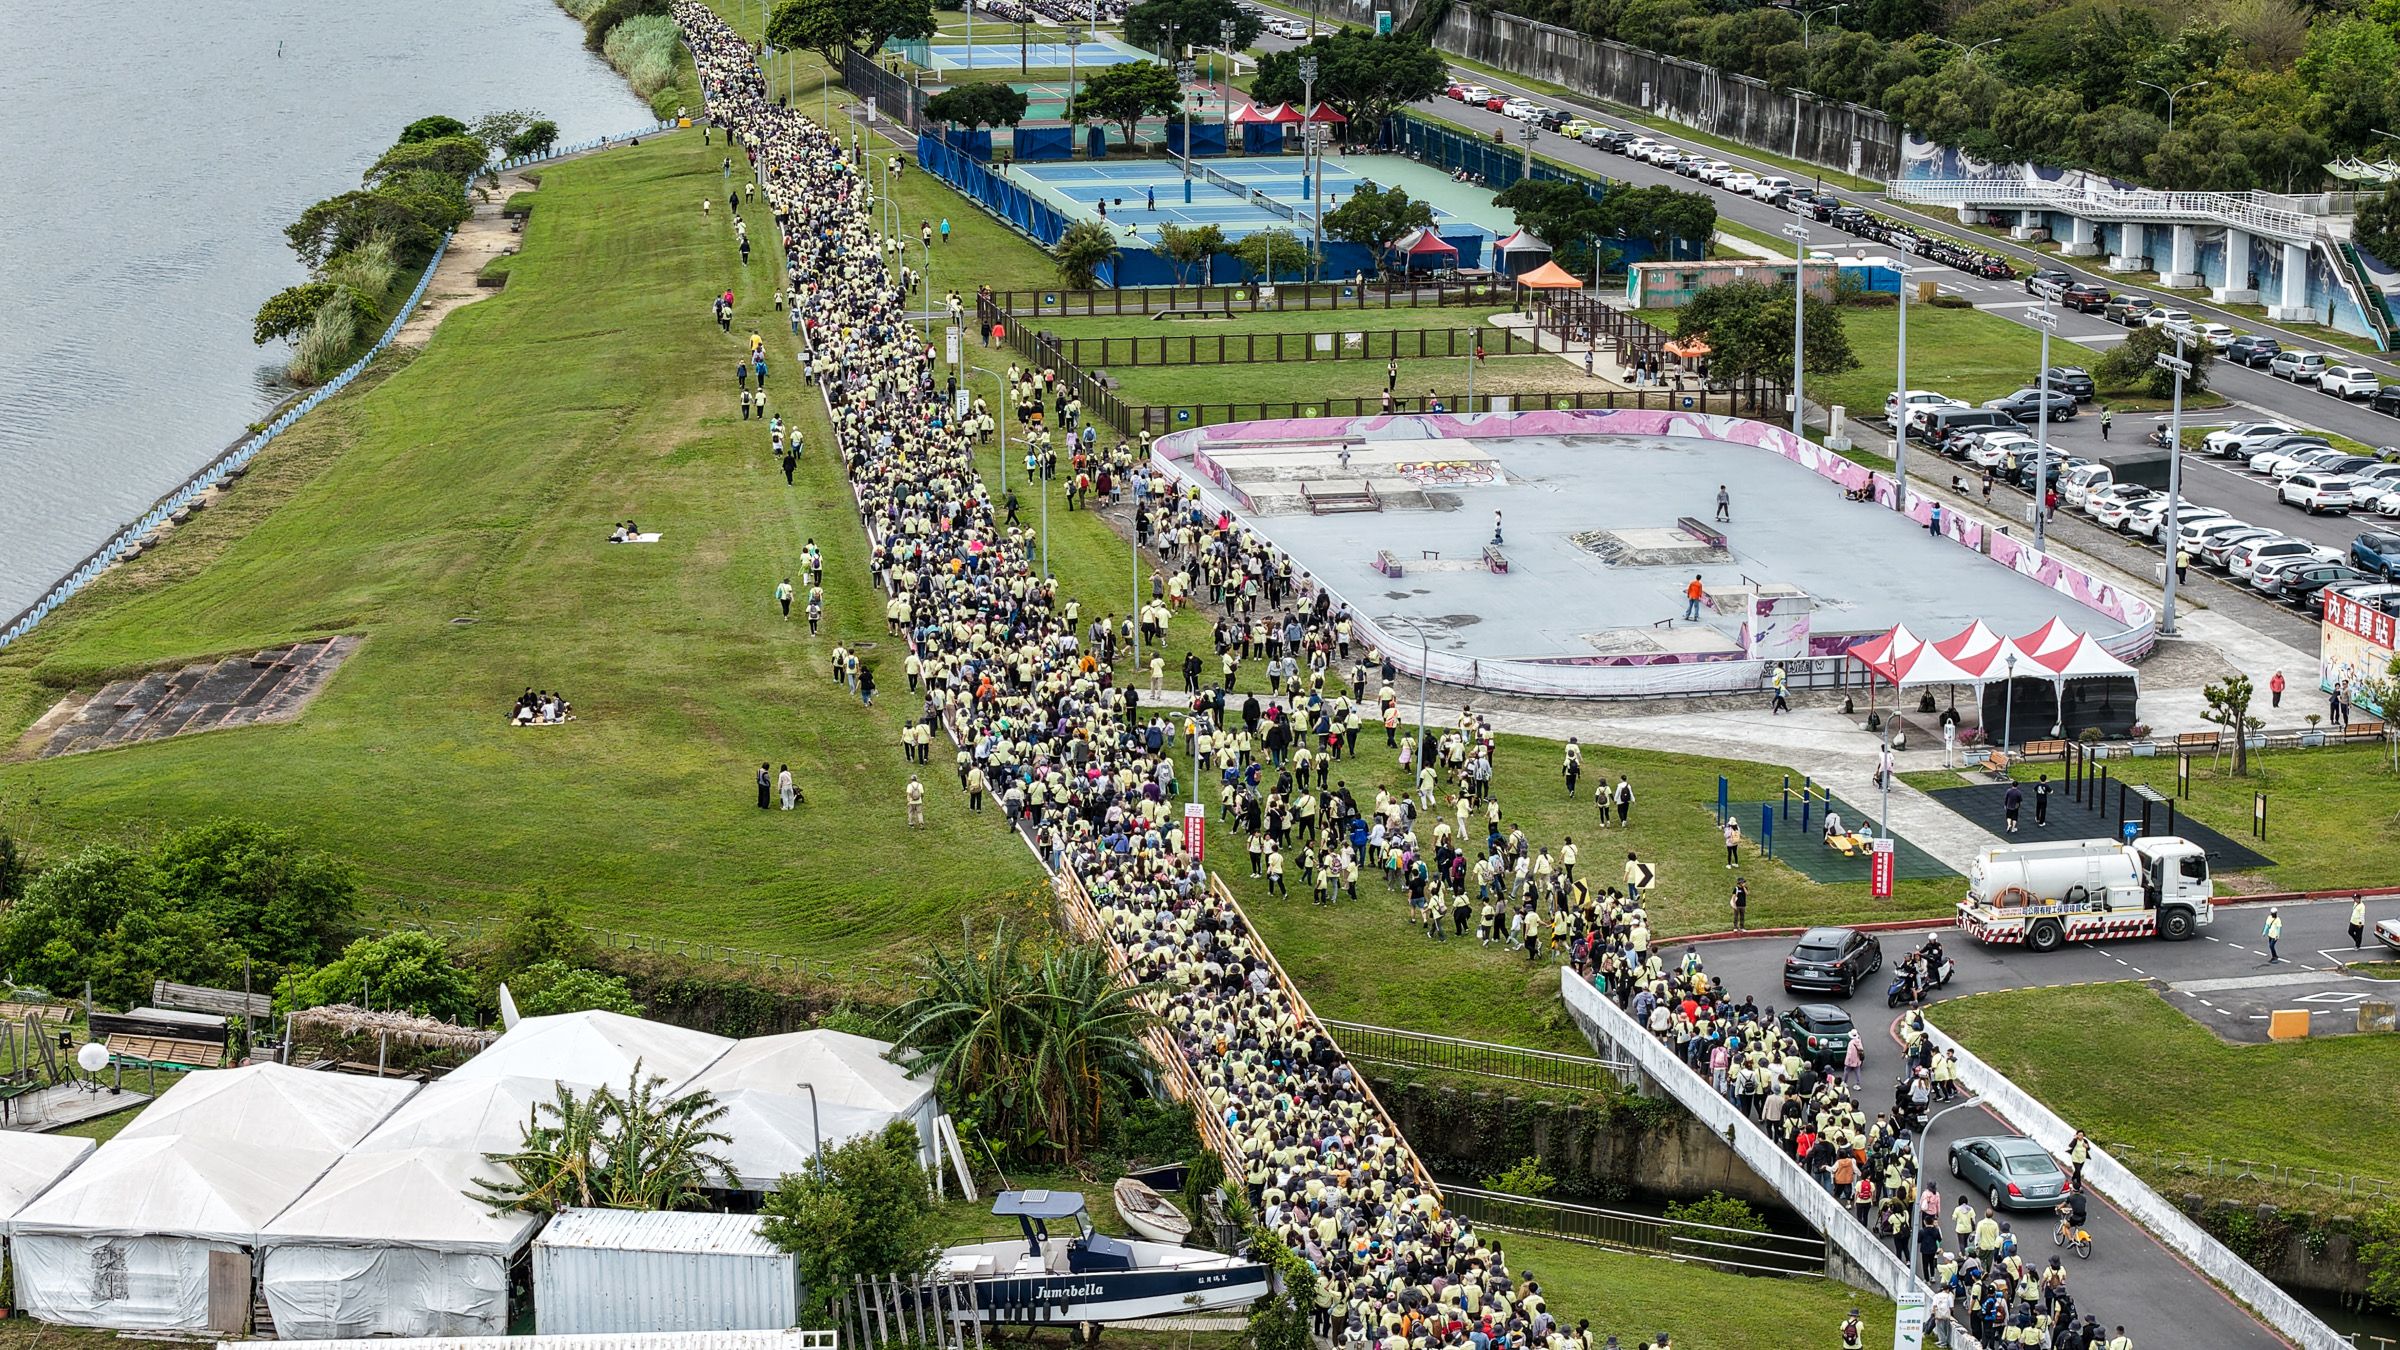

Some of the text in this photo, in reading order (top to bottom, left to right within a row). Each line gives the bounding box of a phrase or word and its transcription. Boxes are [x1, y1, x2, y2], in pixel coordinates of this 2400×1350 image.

[2328, 595, 2388, 646] 內鐵驛站
[1035, 1283, 1103, 1299] Jumabella
